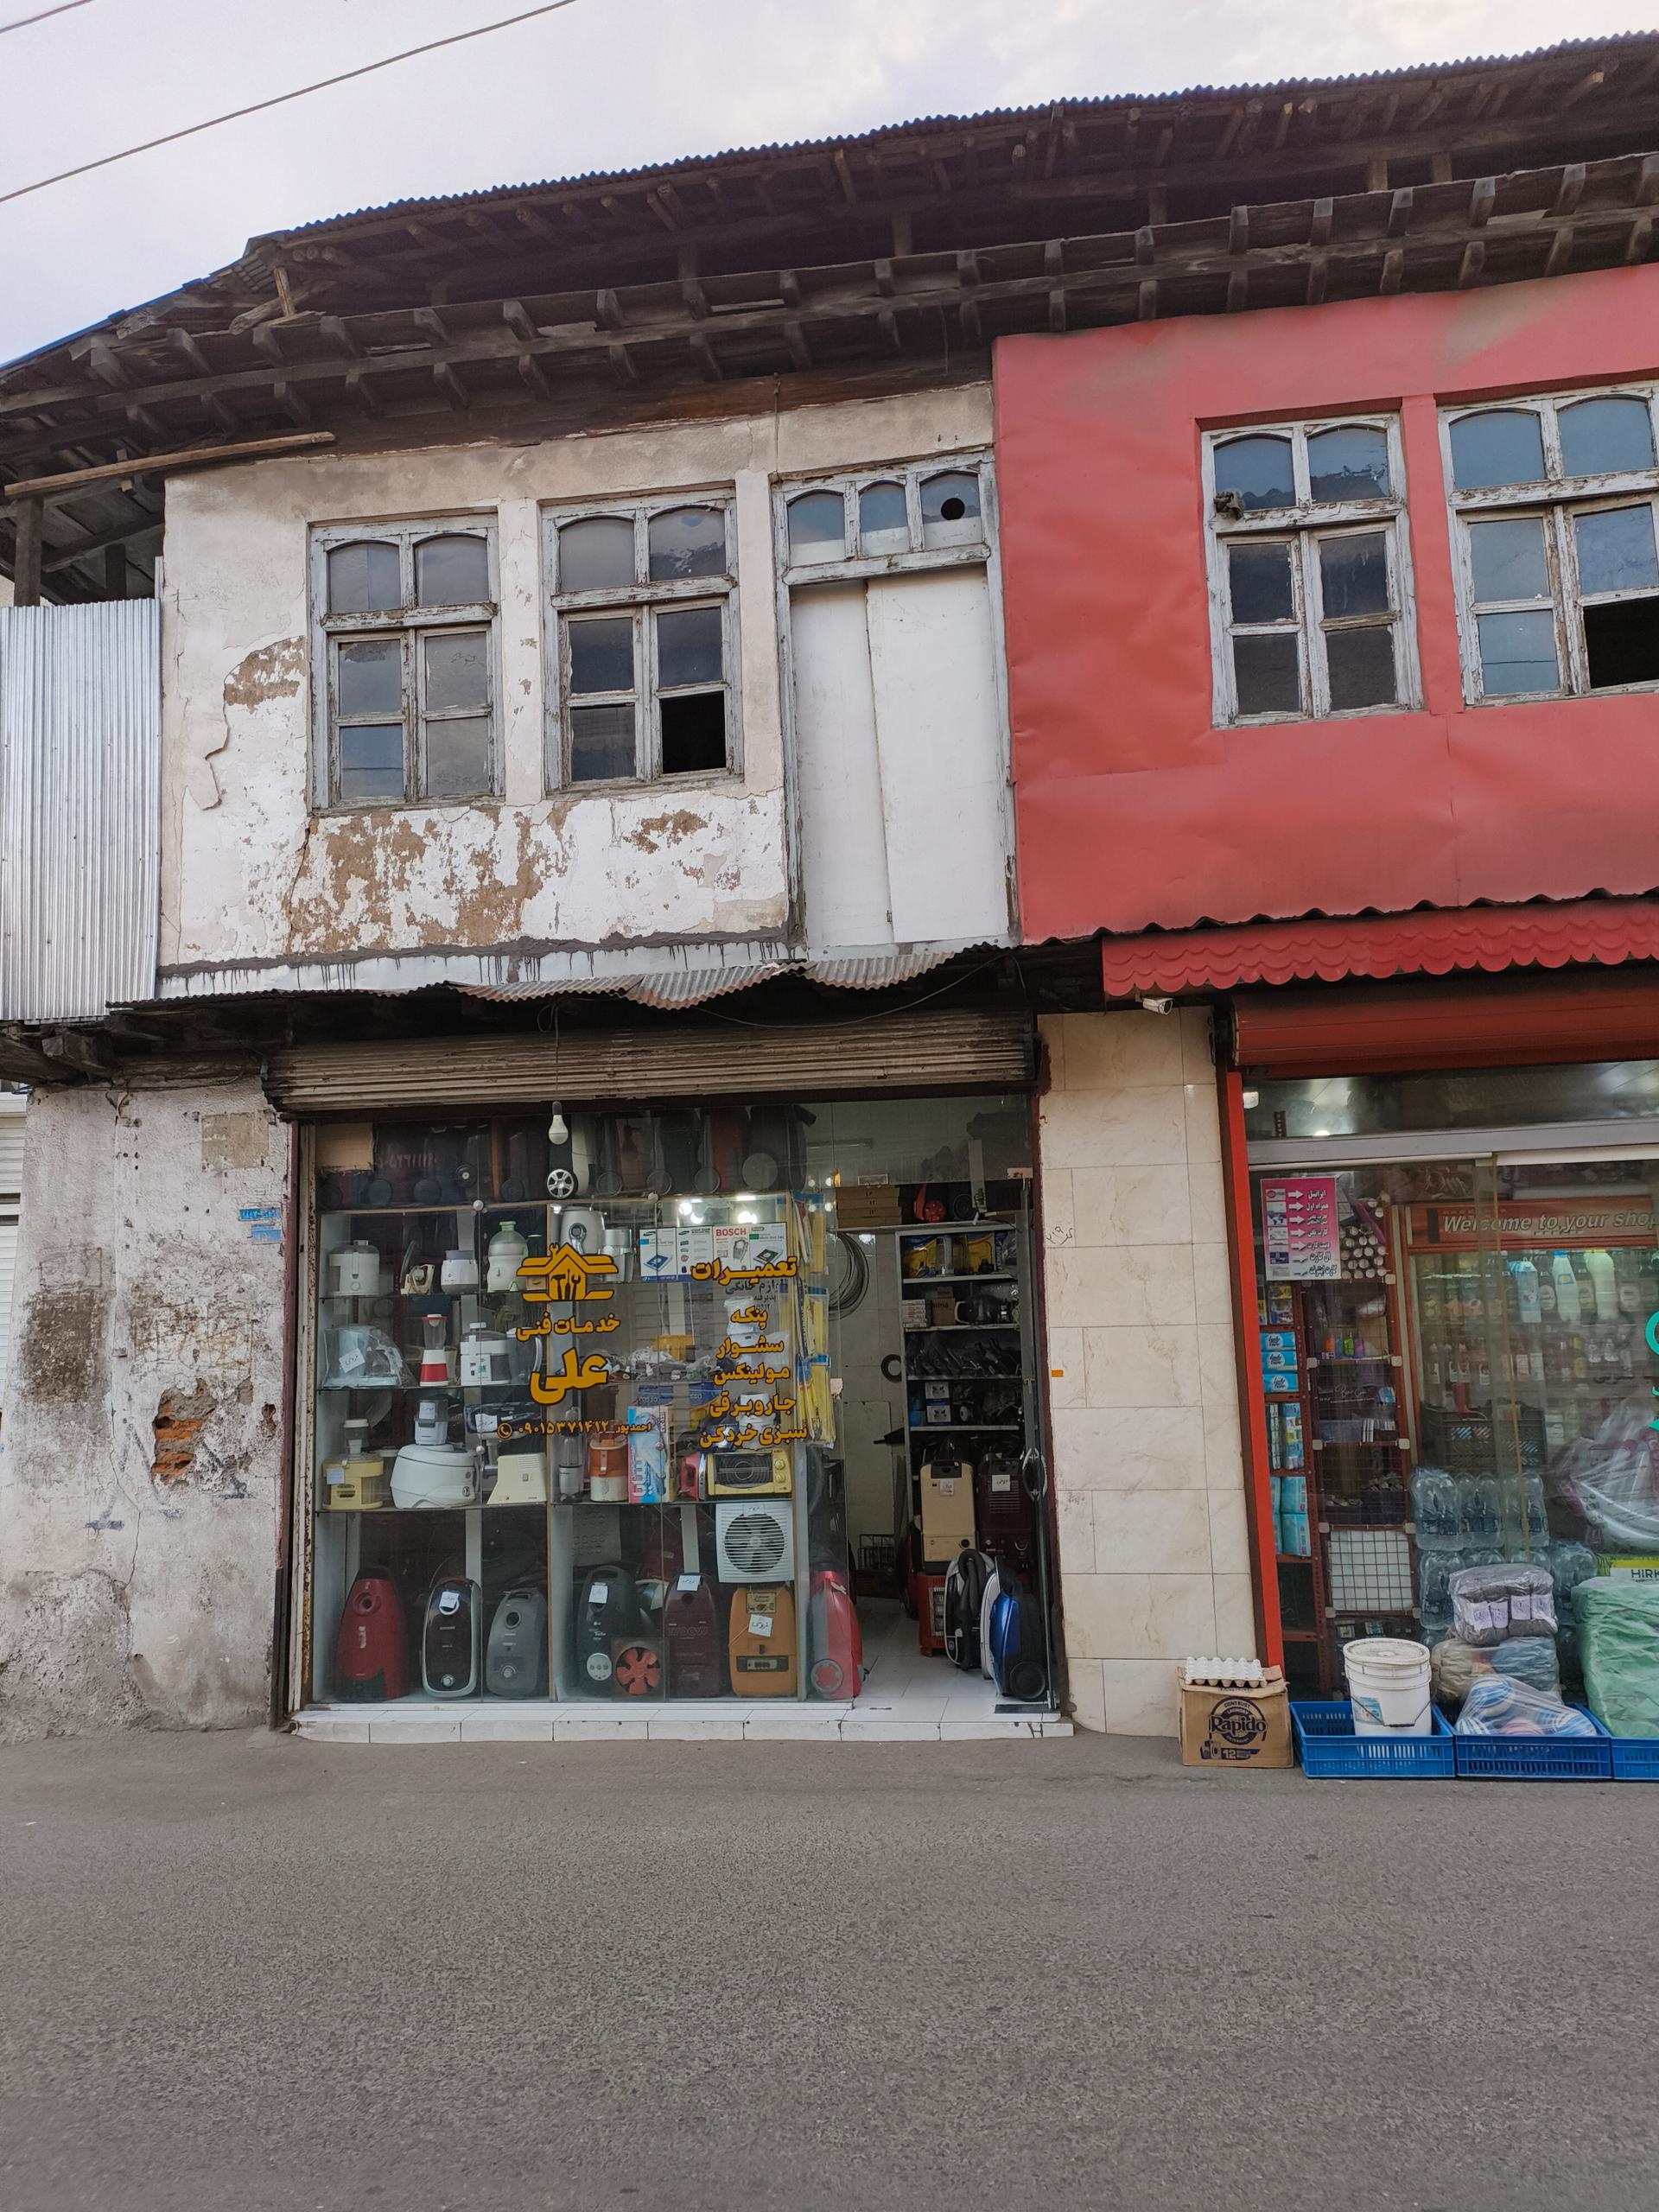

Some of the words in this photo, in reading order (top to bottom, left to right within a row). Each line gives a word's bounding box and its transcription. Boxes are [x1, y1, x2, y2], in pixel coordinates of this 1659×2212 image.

[1306, 1202, 1315, 1211] اول
[1316, 1202, 1329, 1211] همراه
[715, 1228, 747, 1236] BOSCH
[1444, 1215, 1532, 1232] Welcome
[1565, 1213, 1608, 1234] your
[690, 1255, 798, 1287] تعمیرات
[516, 1312, 553, 1341] فنی
[553, 1313, 620, 1334] خدمات
[730, 1305, 768, 1330] پنکه
[716, 1335, 785, 1359] سشوار
[529, 1346, 608, 1407] علی
[713, 1362, 791, 1386] مولینکس
[518, 1420, 609, 1435] ۰۹۰۱۵۳۷۱۴۱۲
[759, 1425, 809, 1446] سبزی
[1210, 1714, 1267, 1736] Rapido
[1223, 1749, 1236, 1759] 12
